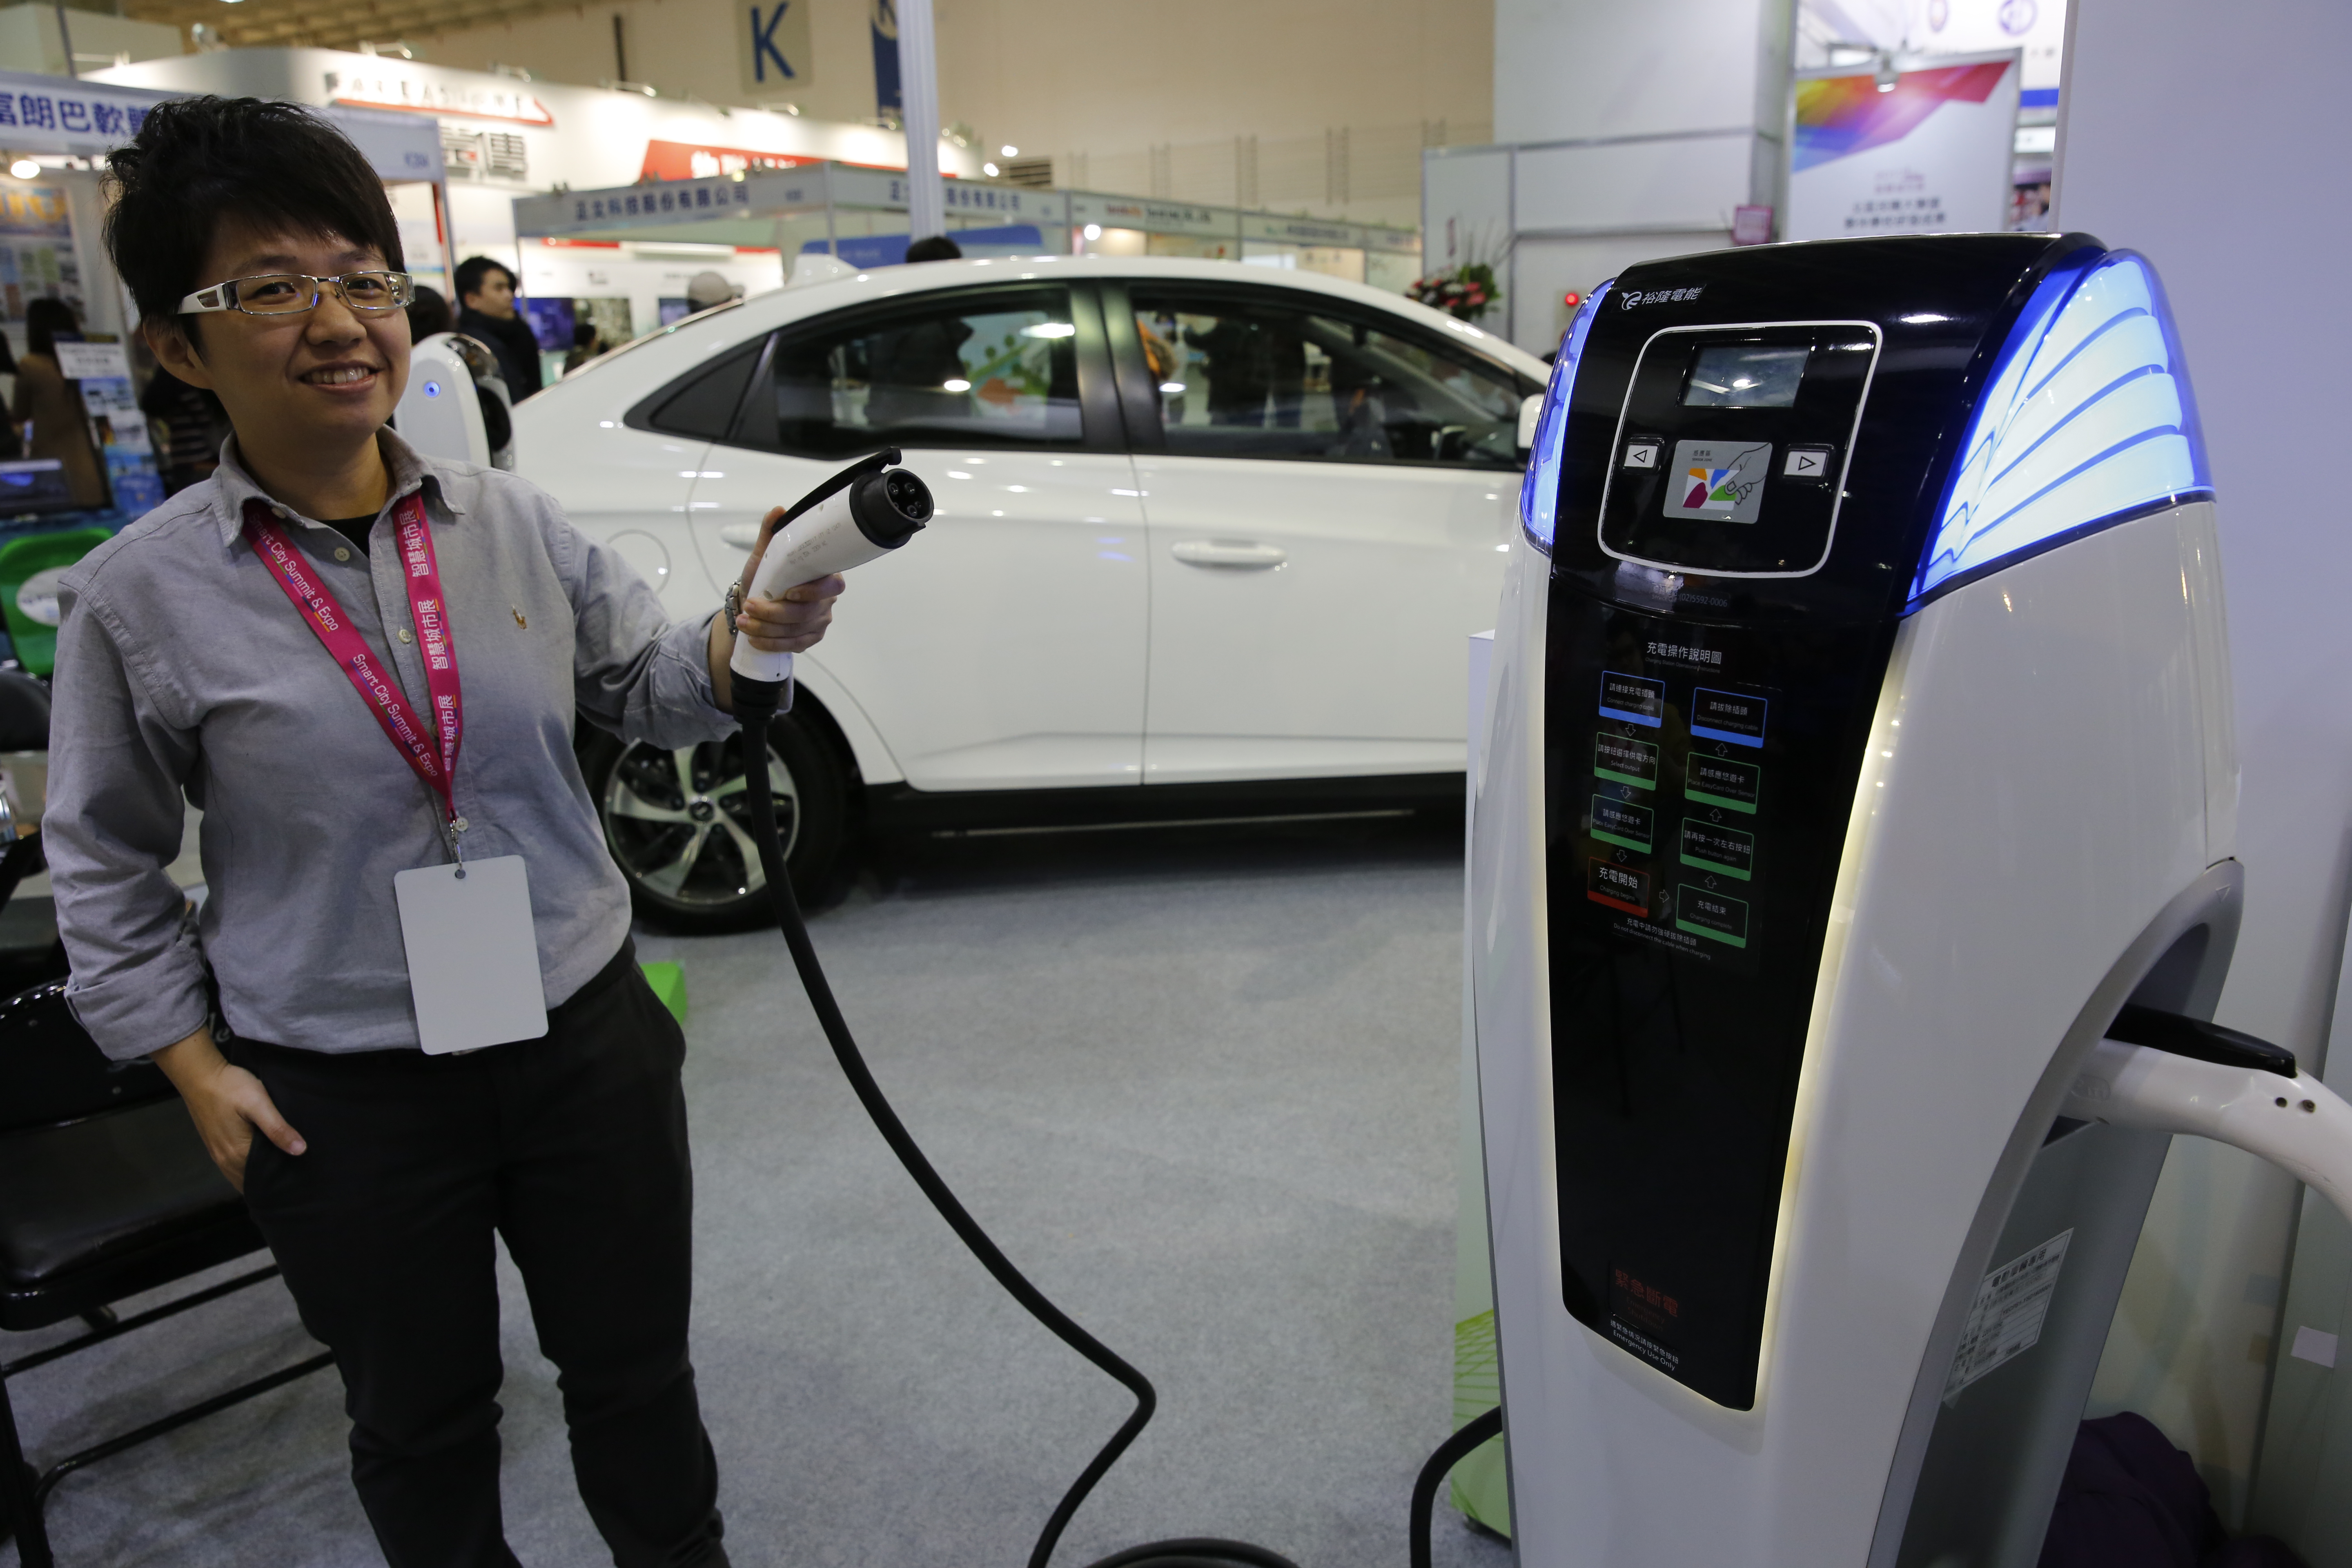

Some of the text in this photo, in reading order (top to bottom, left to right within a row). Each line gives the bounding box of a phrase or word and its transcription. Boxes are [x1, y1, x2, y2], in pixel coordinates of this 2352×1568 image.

[751, 1, 795, 82] K
[1642, 287, 1702, 305] 裕隆電能
[399, 509, 429, 577] 智慧城市展
[249, 513, 339, 631] Smart City Summit & Expo
[417, 599, 448, 670] 智慧城市展
[1646, 641, 1722, 665] 充電操作說明圖
[1609, 683, 1655, 699] 請連接充電插頭
[1607, 697, 1624, 705] Connect
[1624, 701, 1642, 710] charging
[1710, 702, 1748, 716] 請拔除插頭
[353, 653, 438, 776] Smart City Summit & Expo
[1697, 715, 1723, 724] Disconnect
[1723, 720, 1744, 729] charging
[1598, 744, 1656, 765] 請按鈕選擇供電方向
[1611, 760, 1624, 768] Select
[1700, 767, 1745, 784] 請感應悠遊卡
[1701, 782, 1724, 791] EasyCard
[1603, 808, 1641, 825] 請感應悠遊卡
[1604, 822, 1624, 832] EasyCard
[1684, 830, 1751, 854] 請再按一次左右按鈕
[1708, 850, 1723, 858] button
[1599, 867, 1638, 889] 充電開始
[1600, 885, 1635, 901] Charging begins
[1697, 900, 1726, 915] 充電結束
[1690, 913, 1732, 930] Charging complete
[1627, 918, 1697, 947] 充電中請勿強硬拔除插頭
[1629, 929, 1653, 941] disconnect
[1662, 940, 1675, 948] cable
[1689, 949, 1711, 960] charging
[1615, 1269, 1678, 1317] 緊急斷電
[1626, 1296, 1665, 1324] Emergency
[1610, 1319, 1679, 1364] 遇緊急情況請按緊急按鈕
[1613, 1330, 1675, 1371] Emergency Use Only
